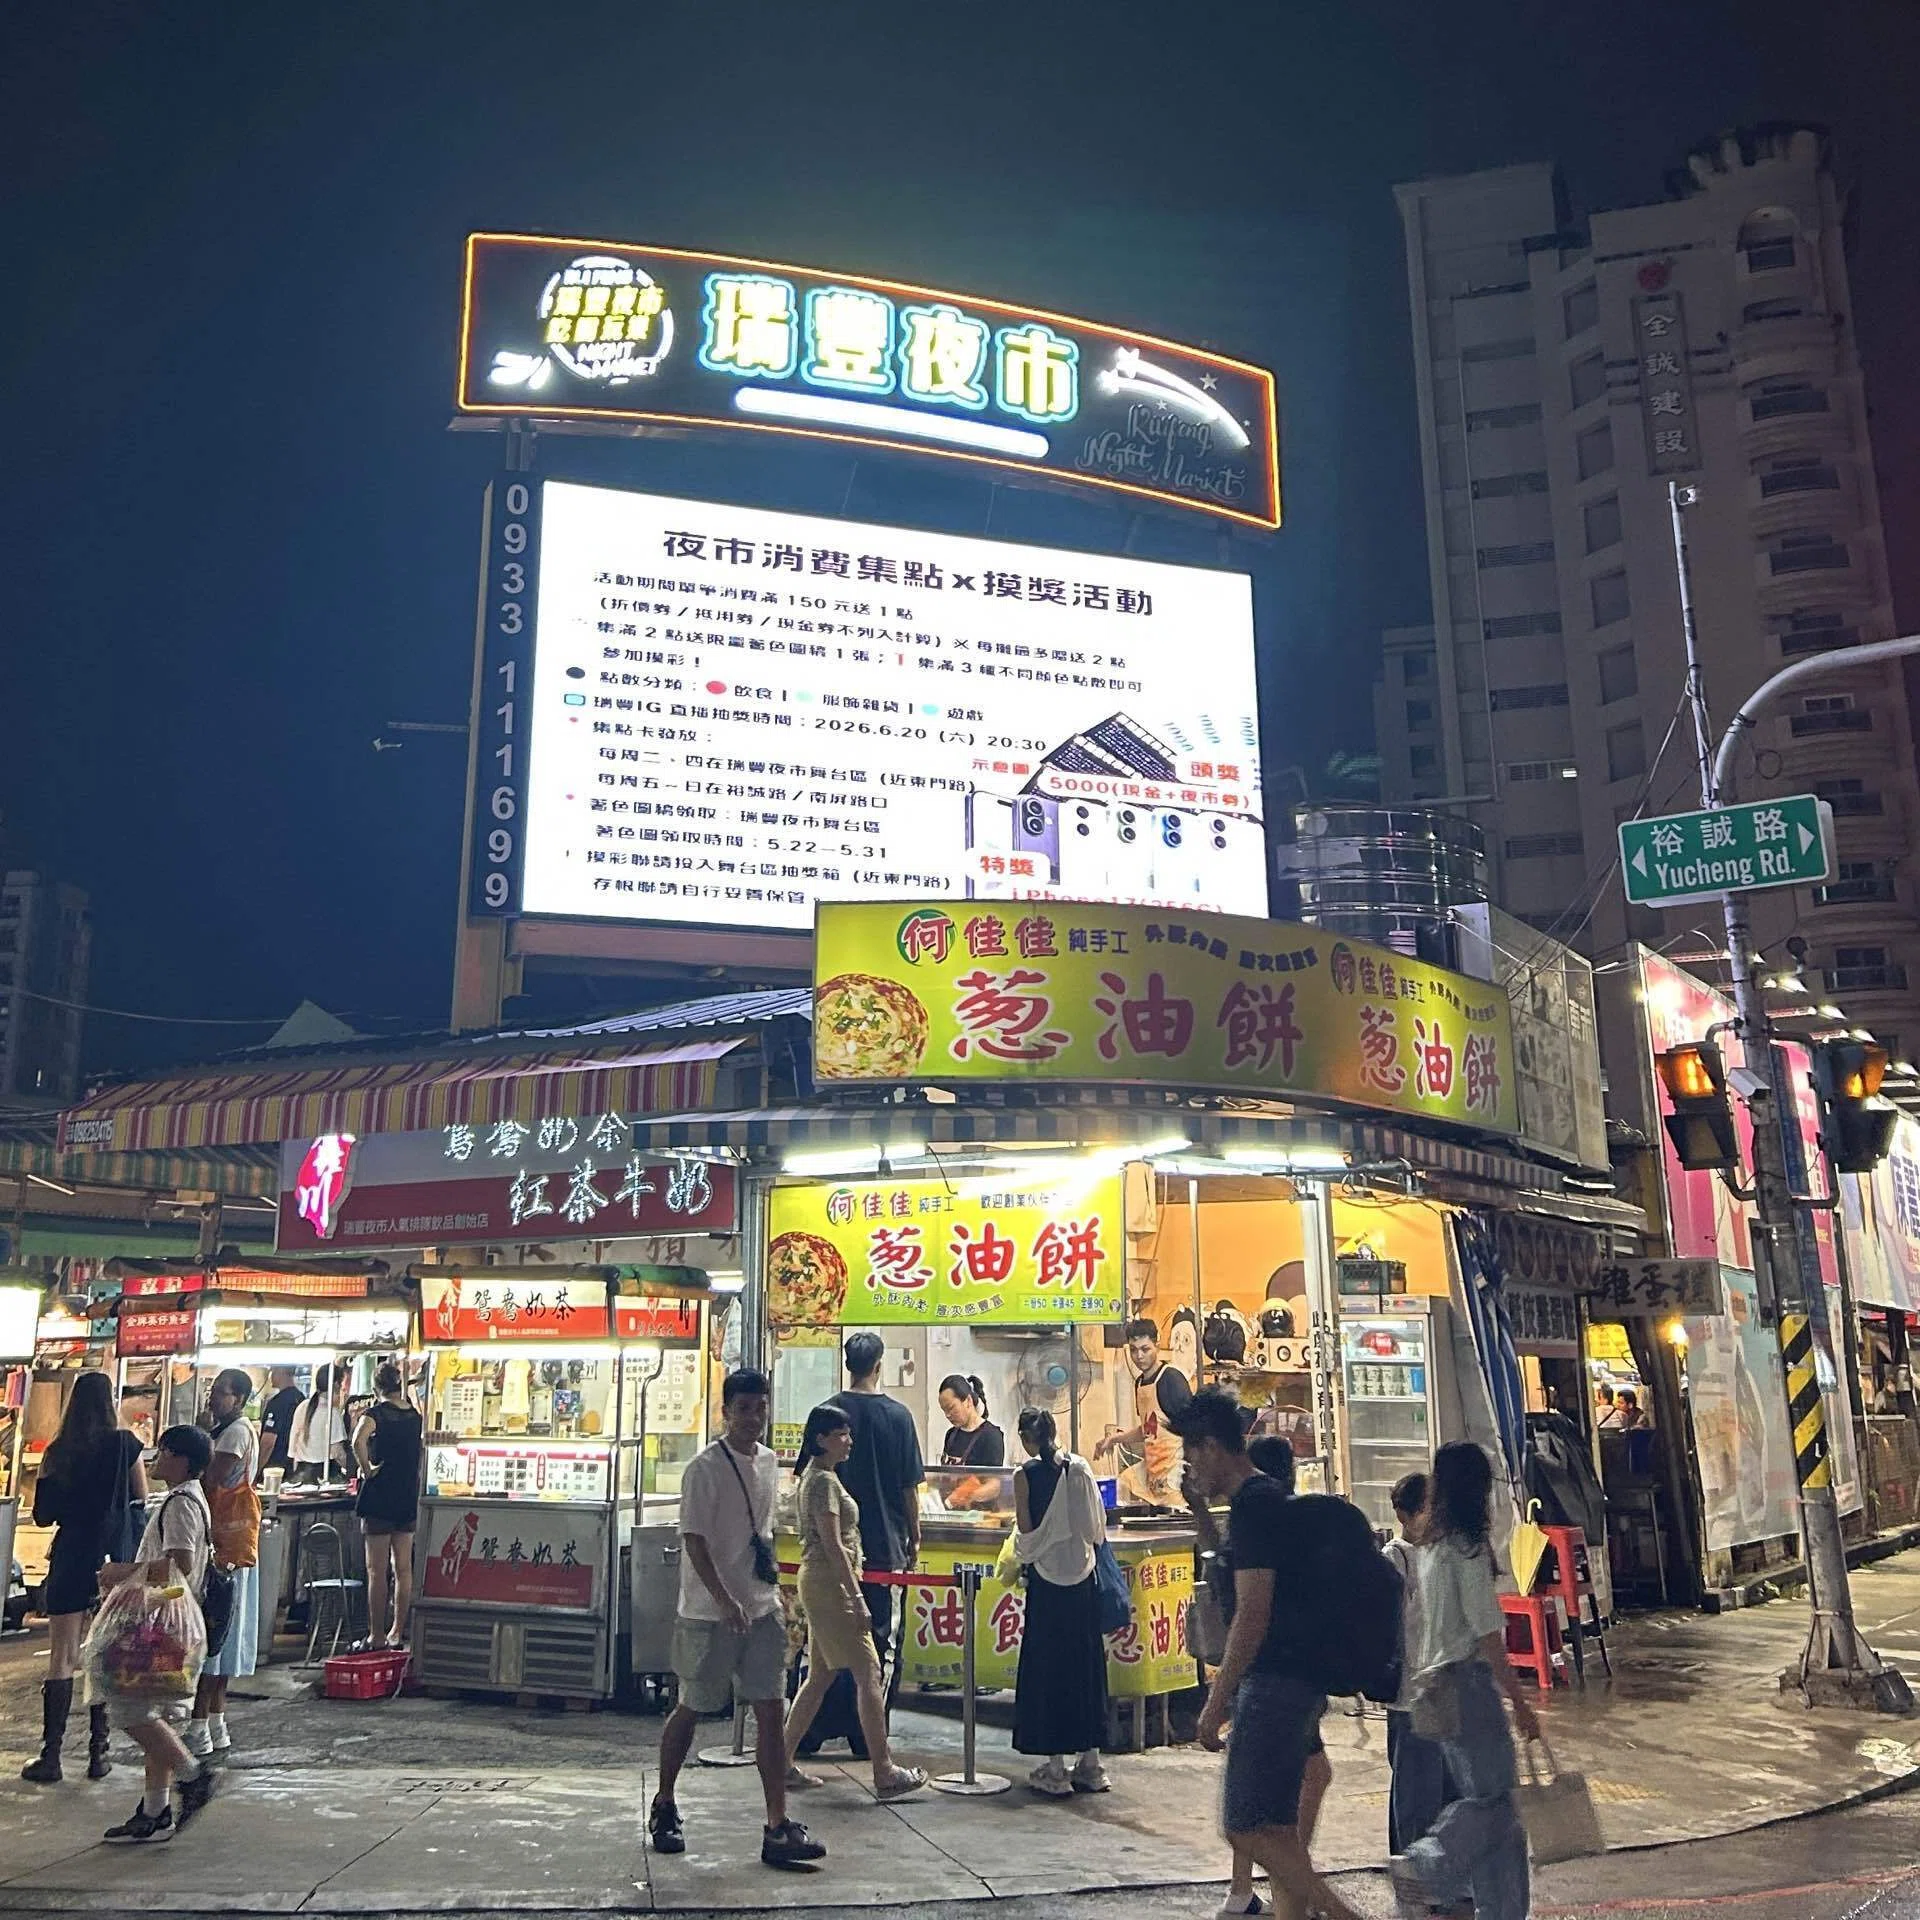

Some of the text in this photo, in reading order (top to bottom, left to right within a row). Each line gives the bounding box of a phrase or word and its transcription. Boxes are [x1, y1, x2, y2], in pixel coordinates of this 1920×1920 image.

[702, 274, 1078, 420] 瑞豐夜市
[1643, 314, 1688, 453] 全誠建設
[1076, 429, 1246, 499] Night Market
[789, 595, 827, 609] 150
[485, 484, 529, 908] 0933 111699
[987, 735, 1046, 751] 20:30
[1191, 761, 1240, 782] 頭獎
[1651, 809, 1788, 858] 裕誠路
[980, 855, 1035, 877] 特獎
[1656, 847, 1796, 890] Yucheng Rd.
[903, 914, 1060, 964] 何佳佳
[1069, 928, 1130, 954] 純手工
[510, 1155, 713, 1226] 紅茶牛奶
[829, 1189, 913, 1224] 何佳佳
[919, 1196, 954, 1213] 純手工
[473, 1286, 576, 1321] 鴛鴦奶茶
[480, 1536, 582, 1573] 鴛鴦奶茶
